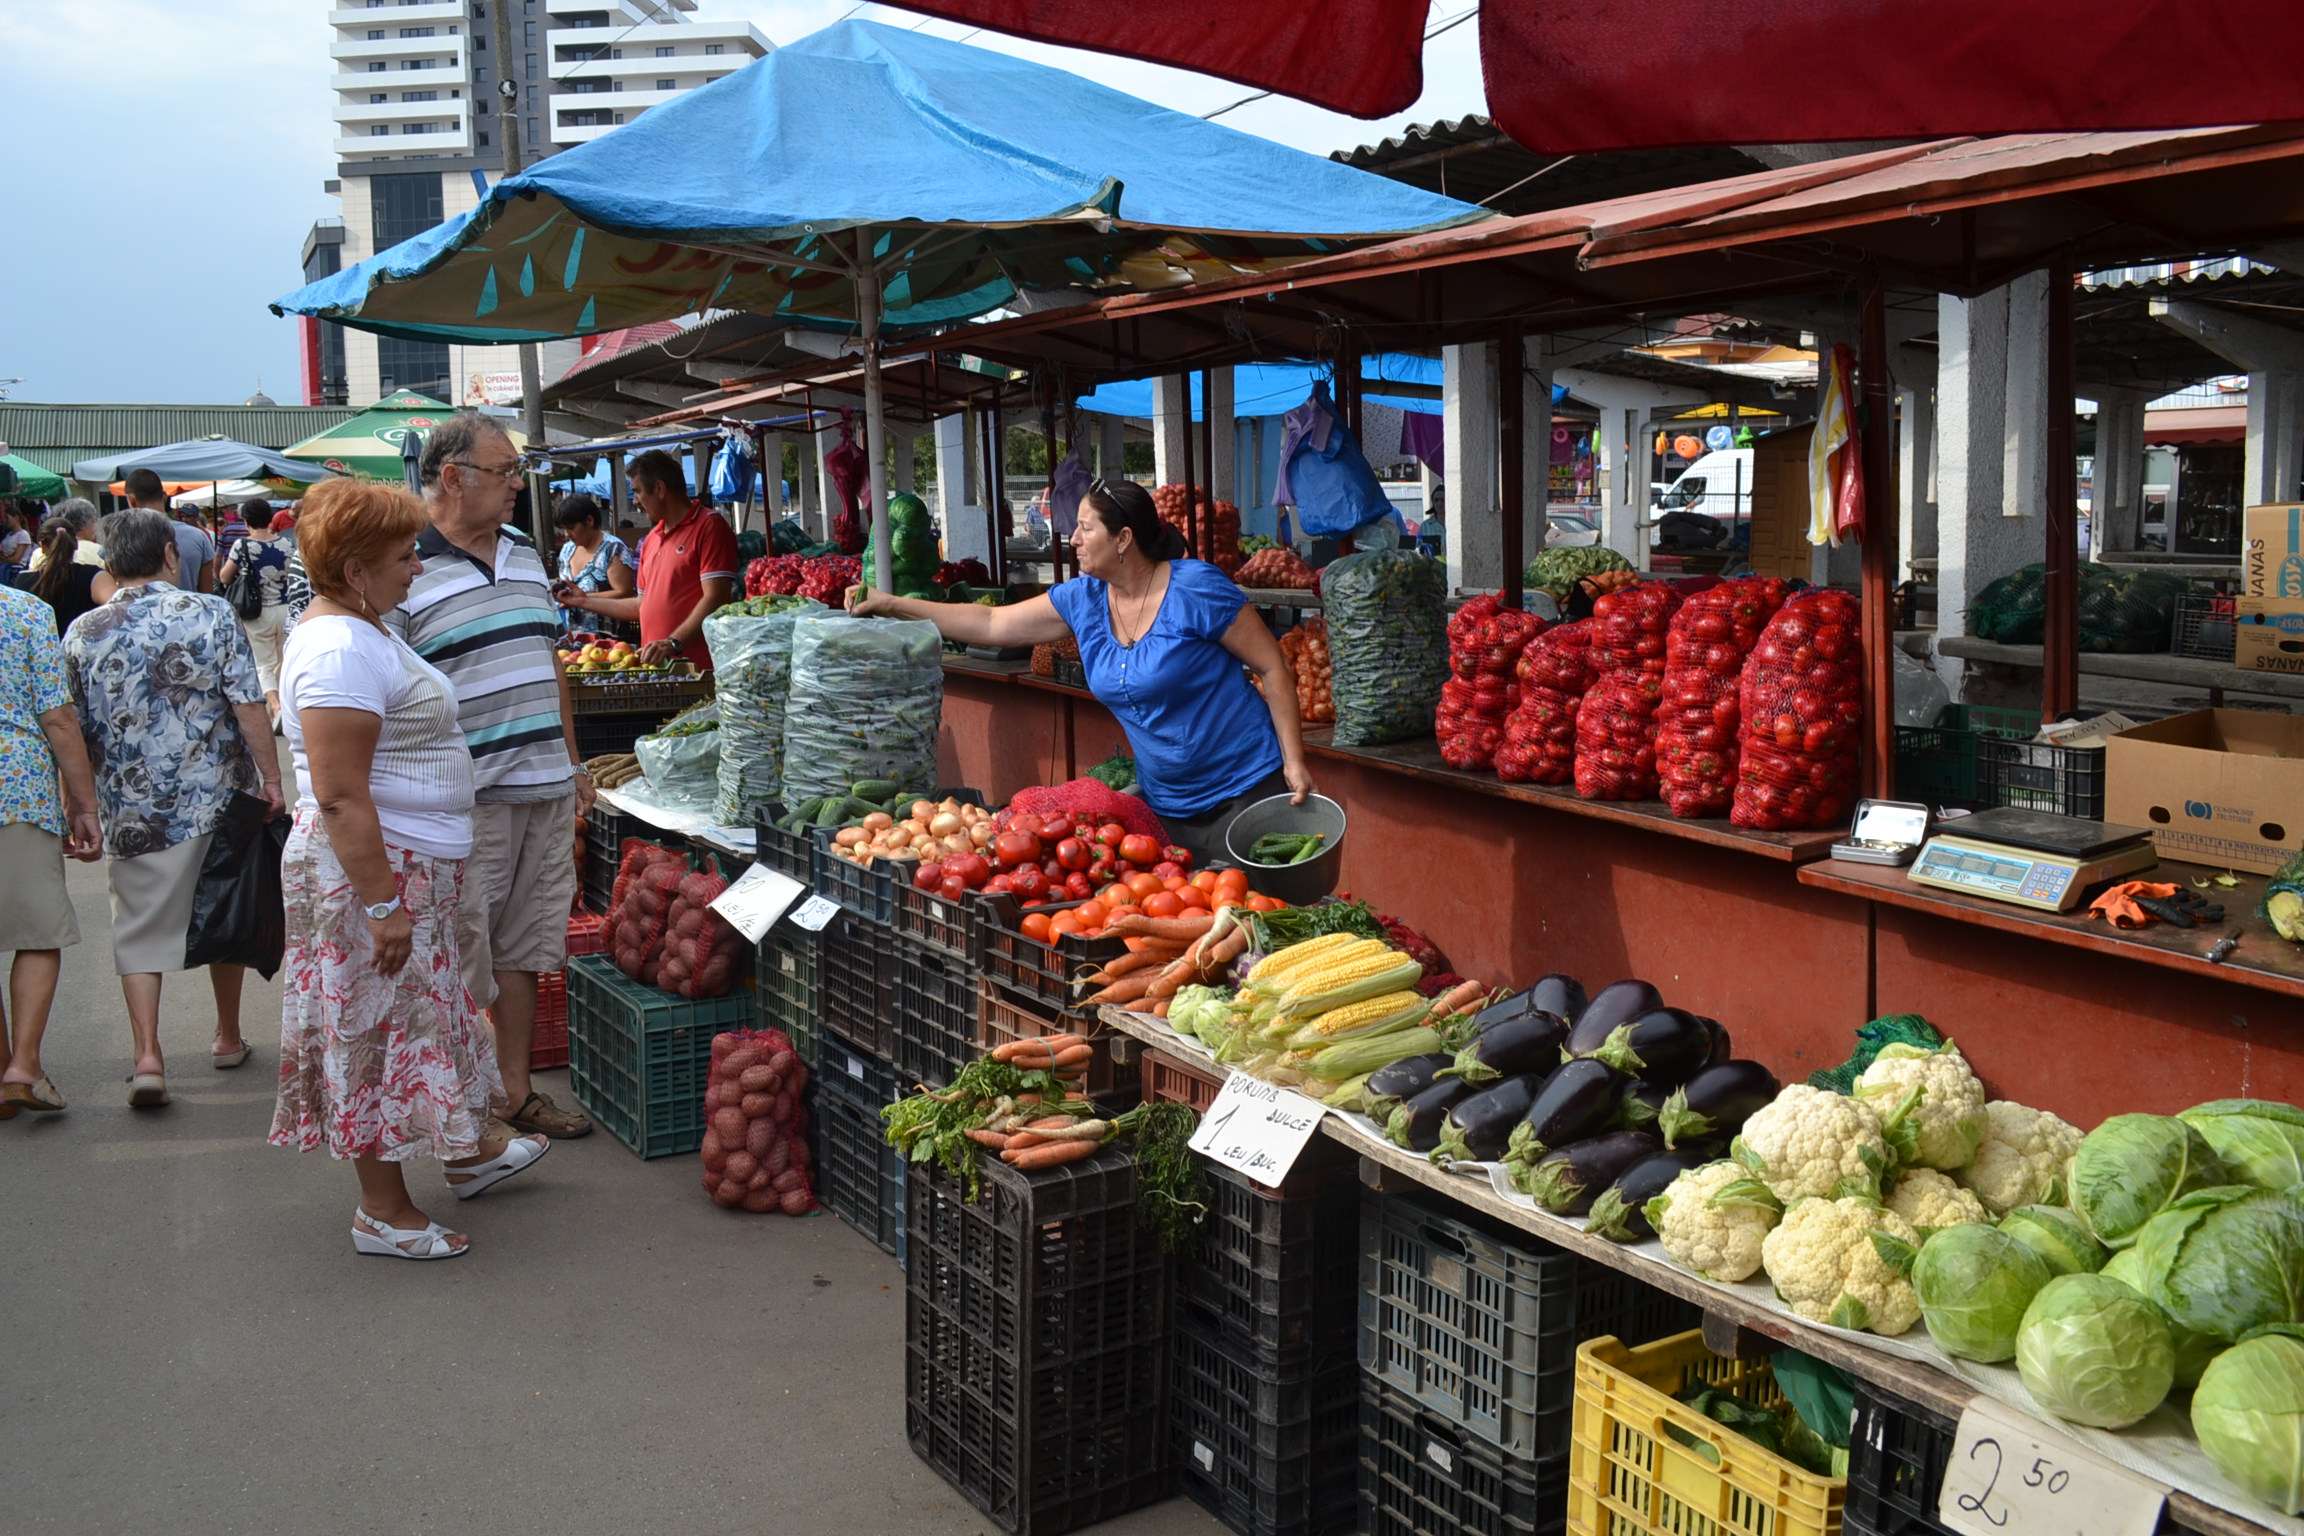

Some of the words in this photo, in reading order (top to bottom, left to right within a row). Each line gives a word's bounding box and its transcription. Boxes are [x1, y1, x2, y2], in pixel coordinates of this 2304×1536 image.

[485, 375, 519, 383] OPENING
[796, 899, 818, 923] 2
[815, 903, 830, 915] 50
[1226, 1075, 1280, 1103] PORUMB
[1203, 1104, 1240, 1150] 1
[1266, 1108, 1311, 1131] DULCE
[1958, 1438, 2008, 1526] 2
[2023, 1458, 2069, 1494] 50
